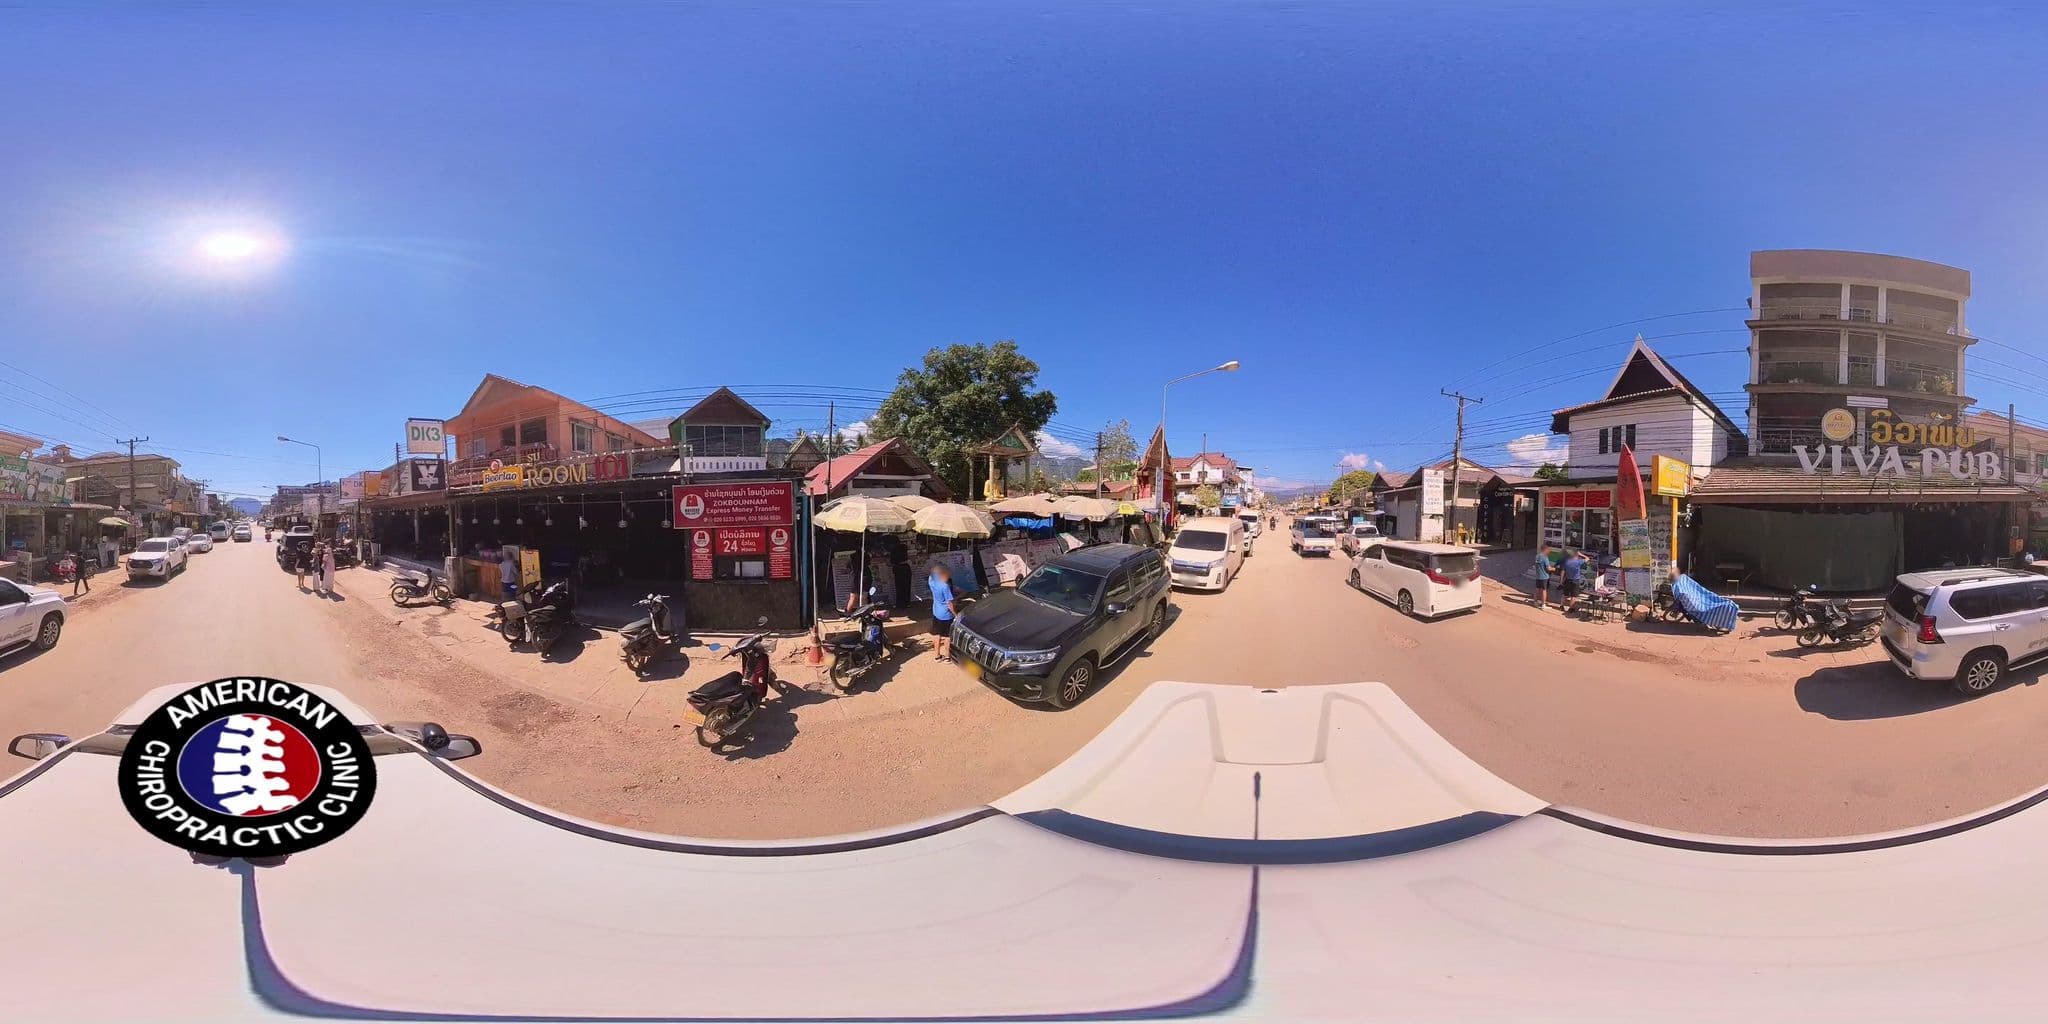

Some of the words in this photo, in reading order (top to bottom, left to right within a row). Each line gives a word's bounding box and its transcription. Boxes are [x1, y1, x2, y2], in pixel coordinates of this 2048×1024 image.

[411, 426, 440, 441] DK3
[1792, 443, 1906, 478] VIVA
[1920, 447, 2002, 480] PUB
[527, 463, 587, 487] ROOM
[723, 540, 738, 553] 24
